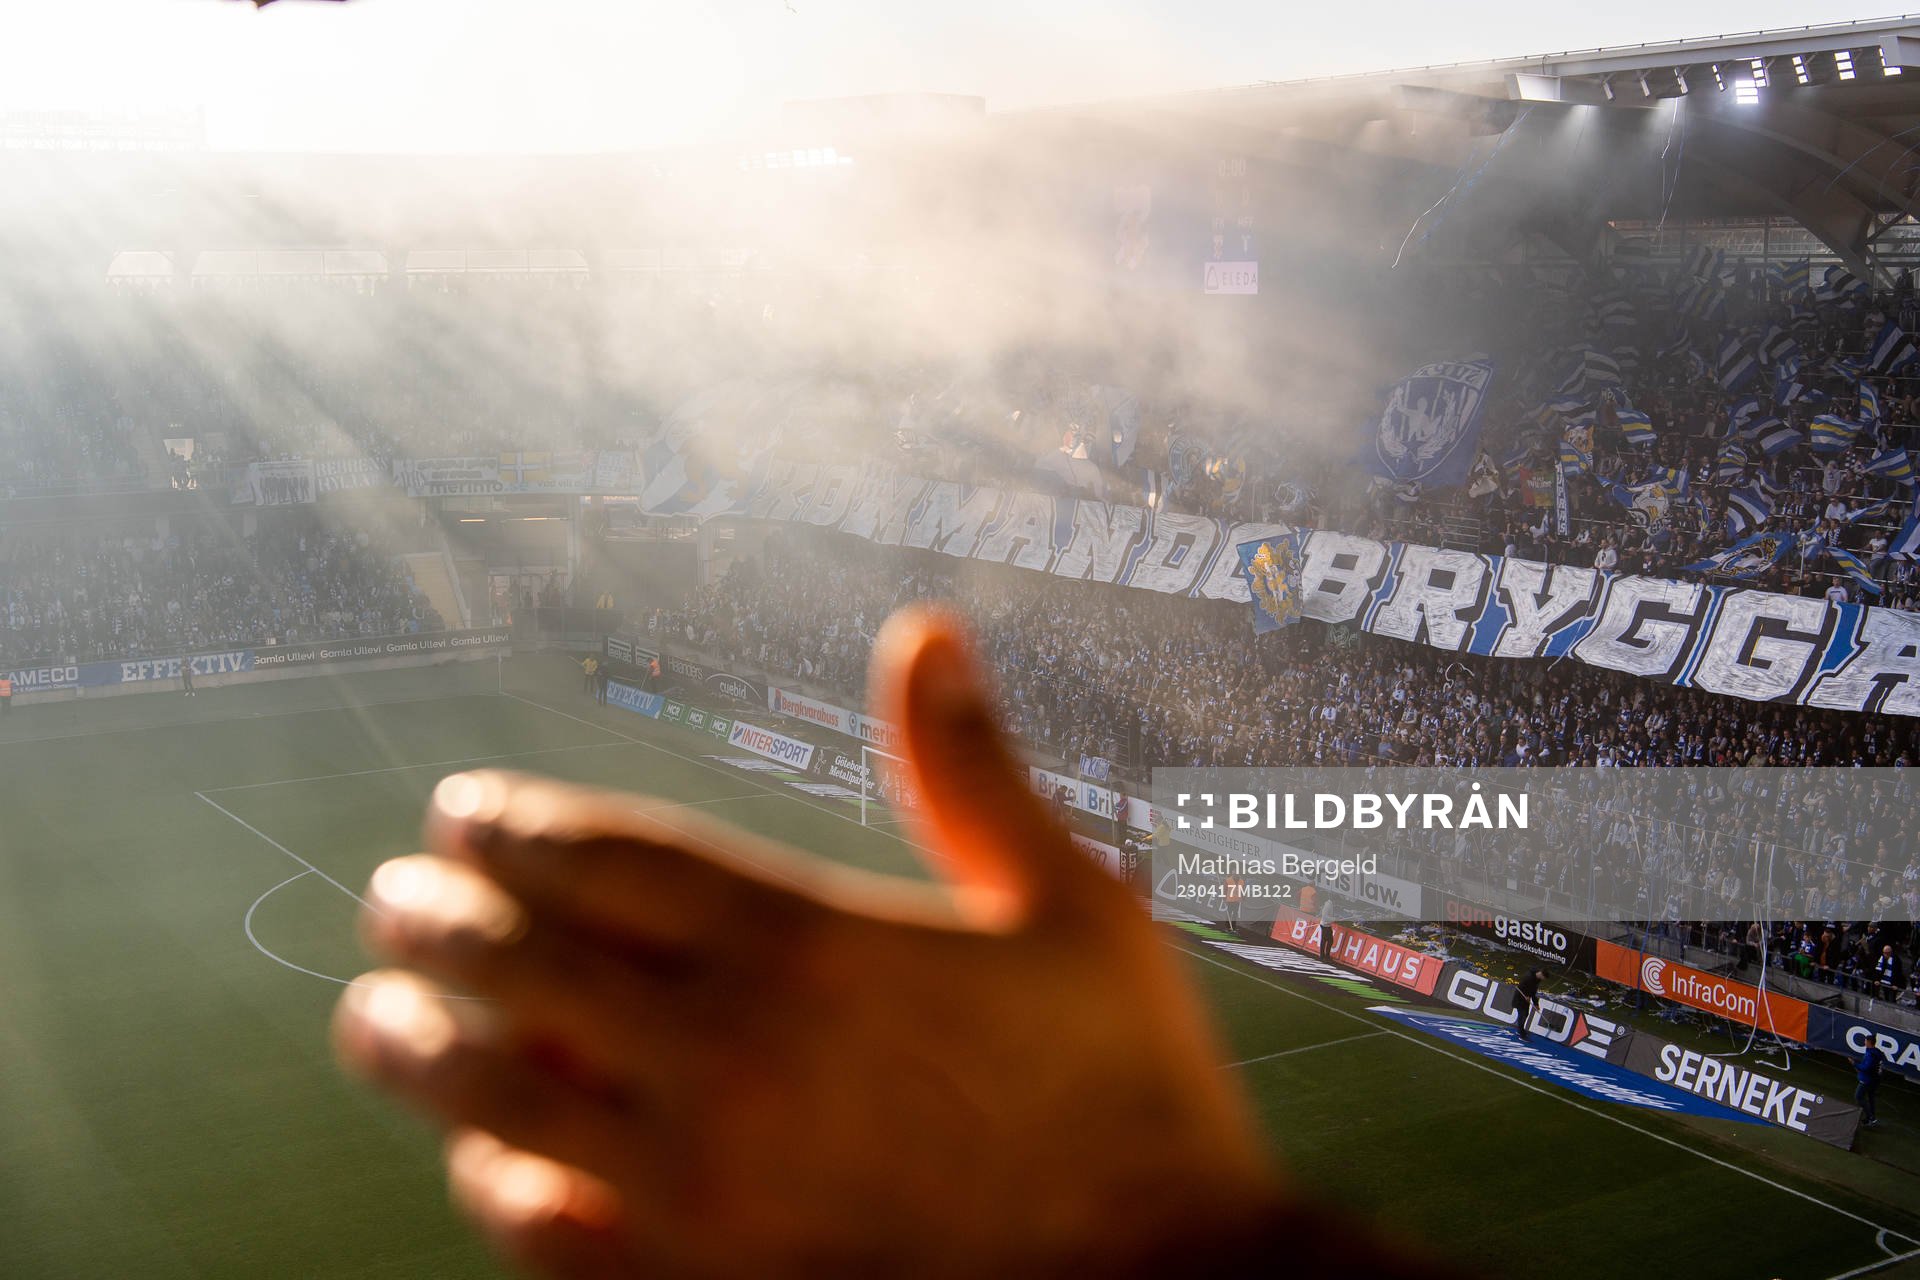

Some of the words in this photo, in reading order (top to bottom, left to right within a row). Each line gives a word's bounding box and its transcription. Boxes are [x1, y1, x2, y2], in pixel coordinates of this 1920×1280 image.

[321, 648, 352, 659] Gamla
[354, 645, 382, 657] Ullevi
[387, 641, 417, 653] Gamla
[419, 639, 446, 650] Ullevi
[451, 636, 481, 647] Gamla
[483, 633, 509, 645] Ullevi
[254, 653, 285, 665] Gamla
[287, 651, 315, 664] Ullevi
[781, 699, 840, 728] Bergkvarabuss
[741, 728, 809, 764] INTERSPORT
[1291, 916, 1421, 980] BAUHAUS
[1672, 970, 1756, 1018] InfraCom
[1654, 1044, 1816, 1132] SERNEKE
